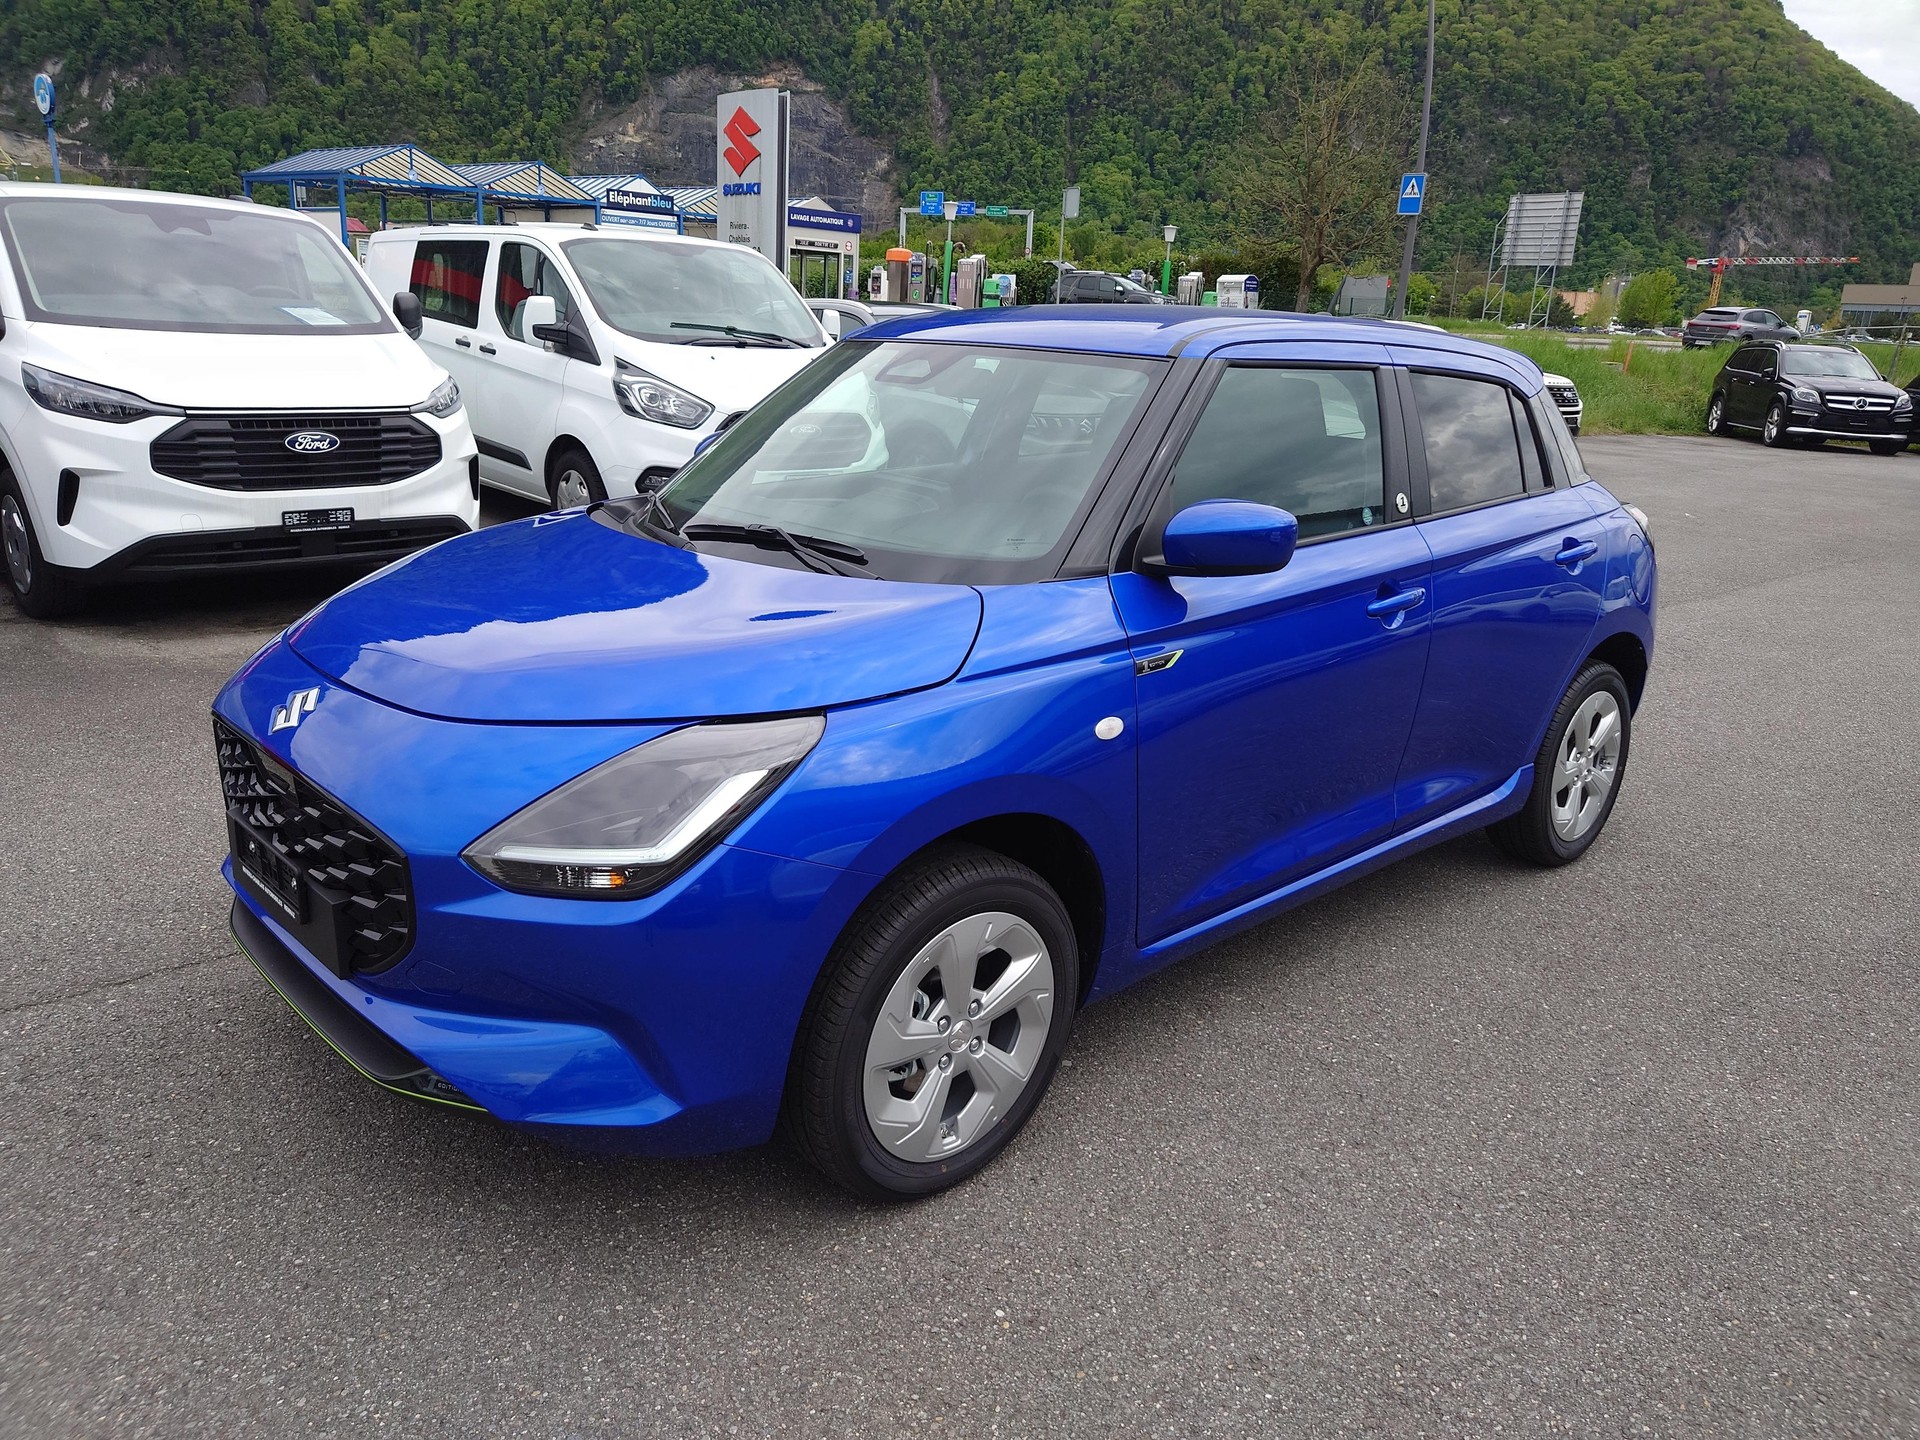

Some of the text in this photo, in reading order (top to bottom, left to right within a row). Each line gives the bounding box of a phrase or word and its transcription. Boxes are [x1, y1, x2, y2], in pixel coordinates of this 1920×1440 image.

[722, 182, 761, 197] SUZUKI
[601, 215, 620, 223] OUVERT
[658, 221, 676, 229] OUVERT
[729, 221, 749, 230] Riviera-
[790, 213, 810, 222] LAVAGE
[810, 215, 844, 226] AUTOMATIQUE
[728, 233, 751, 243] Chablais
[295, 434, 330, 450] Ford
[1142, 660, 1150, 673] 1
